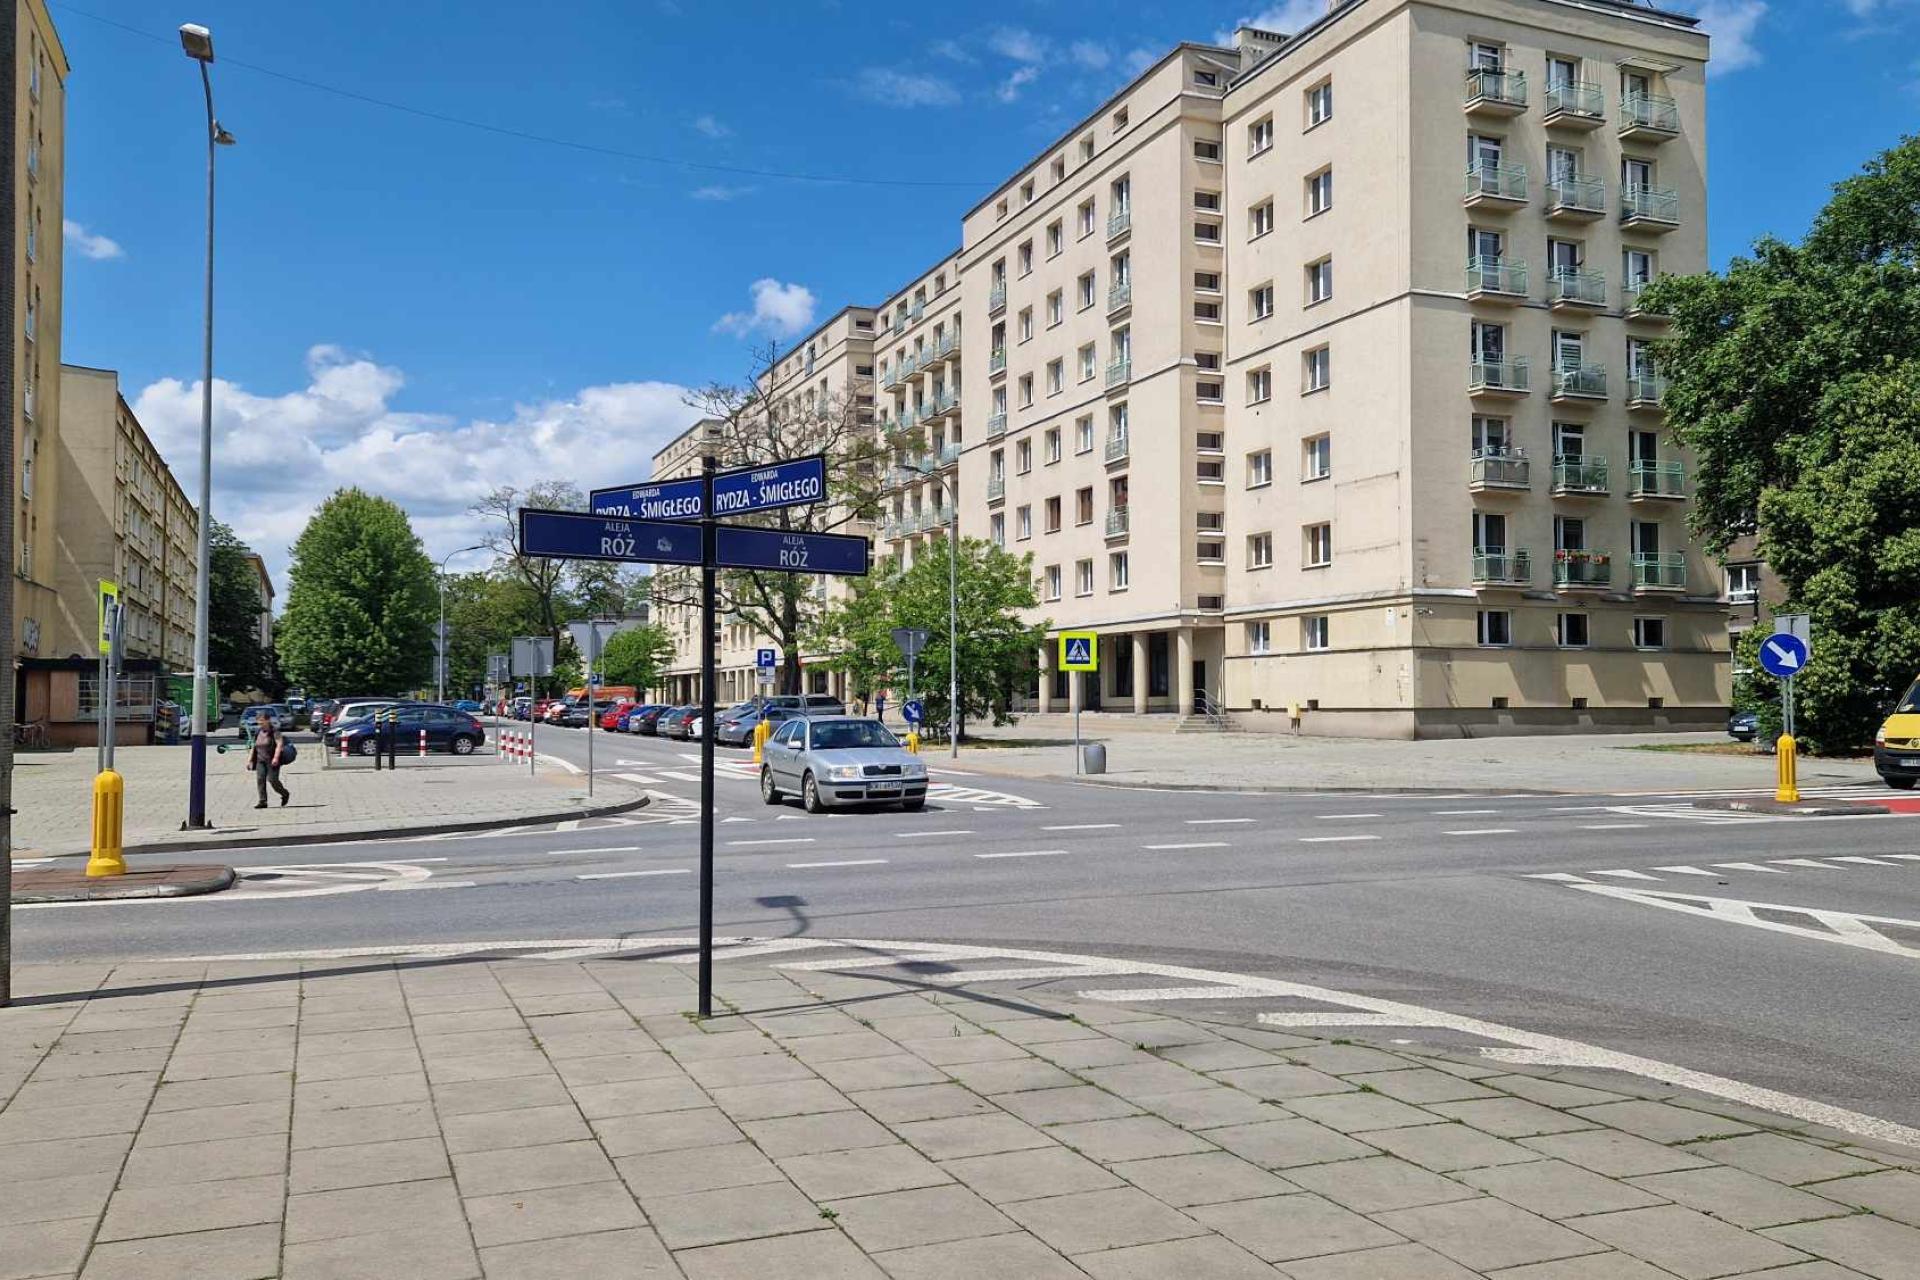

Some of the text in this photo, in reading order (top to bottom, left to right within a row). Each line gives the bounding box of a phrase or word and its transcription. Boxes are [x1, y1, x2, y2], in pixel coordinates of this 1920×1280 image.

[751, 469, 779, 483] EDWARDA
[632, 488, 660, 500] EDWARDA
[716, 489, 750, 511] RYDZA
[760, 477, 819, 504] ŚMIGŁEGO
[640, 496, 701, 519] ŚMIGŁEGO
[604, 522, 631, 533] ALEJA
[600, 533, 636, 557] RÓŻ
[782, 535, 805, 546] ALEJA
[780, 546, 809, 567] RÓŻ
[761, 651, 773, 665] P
